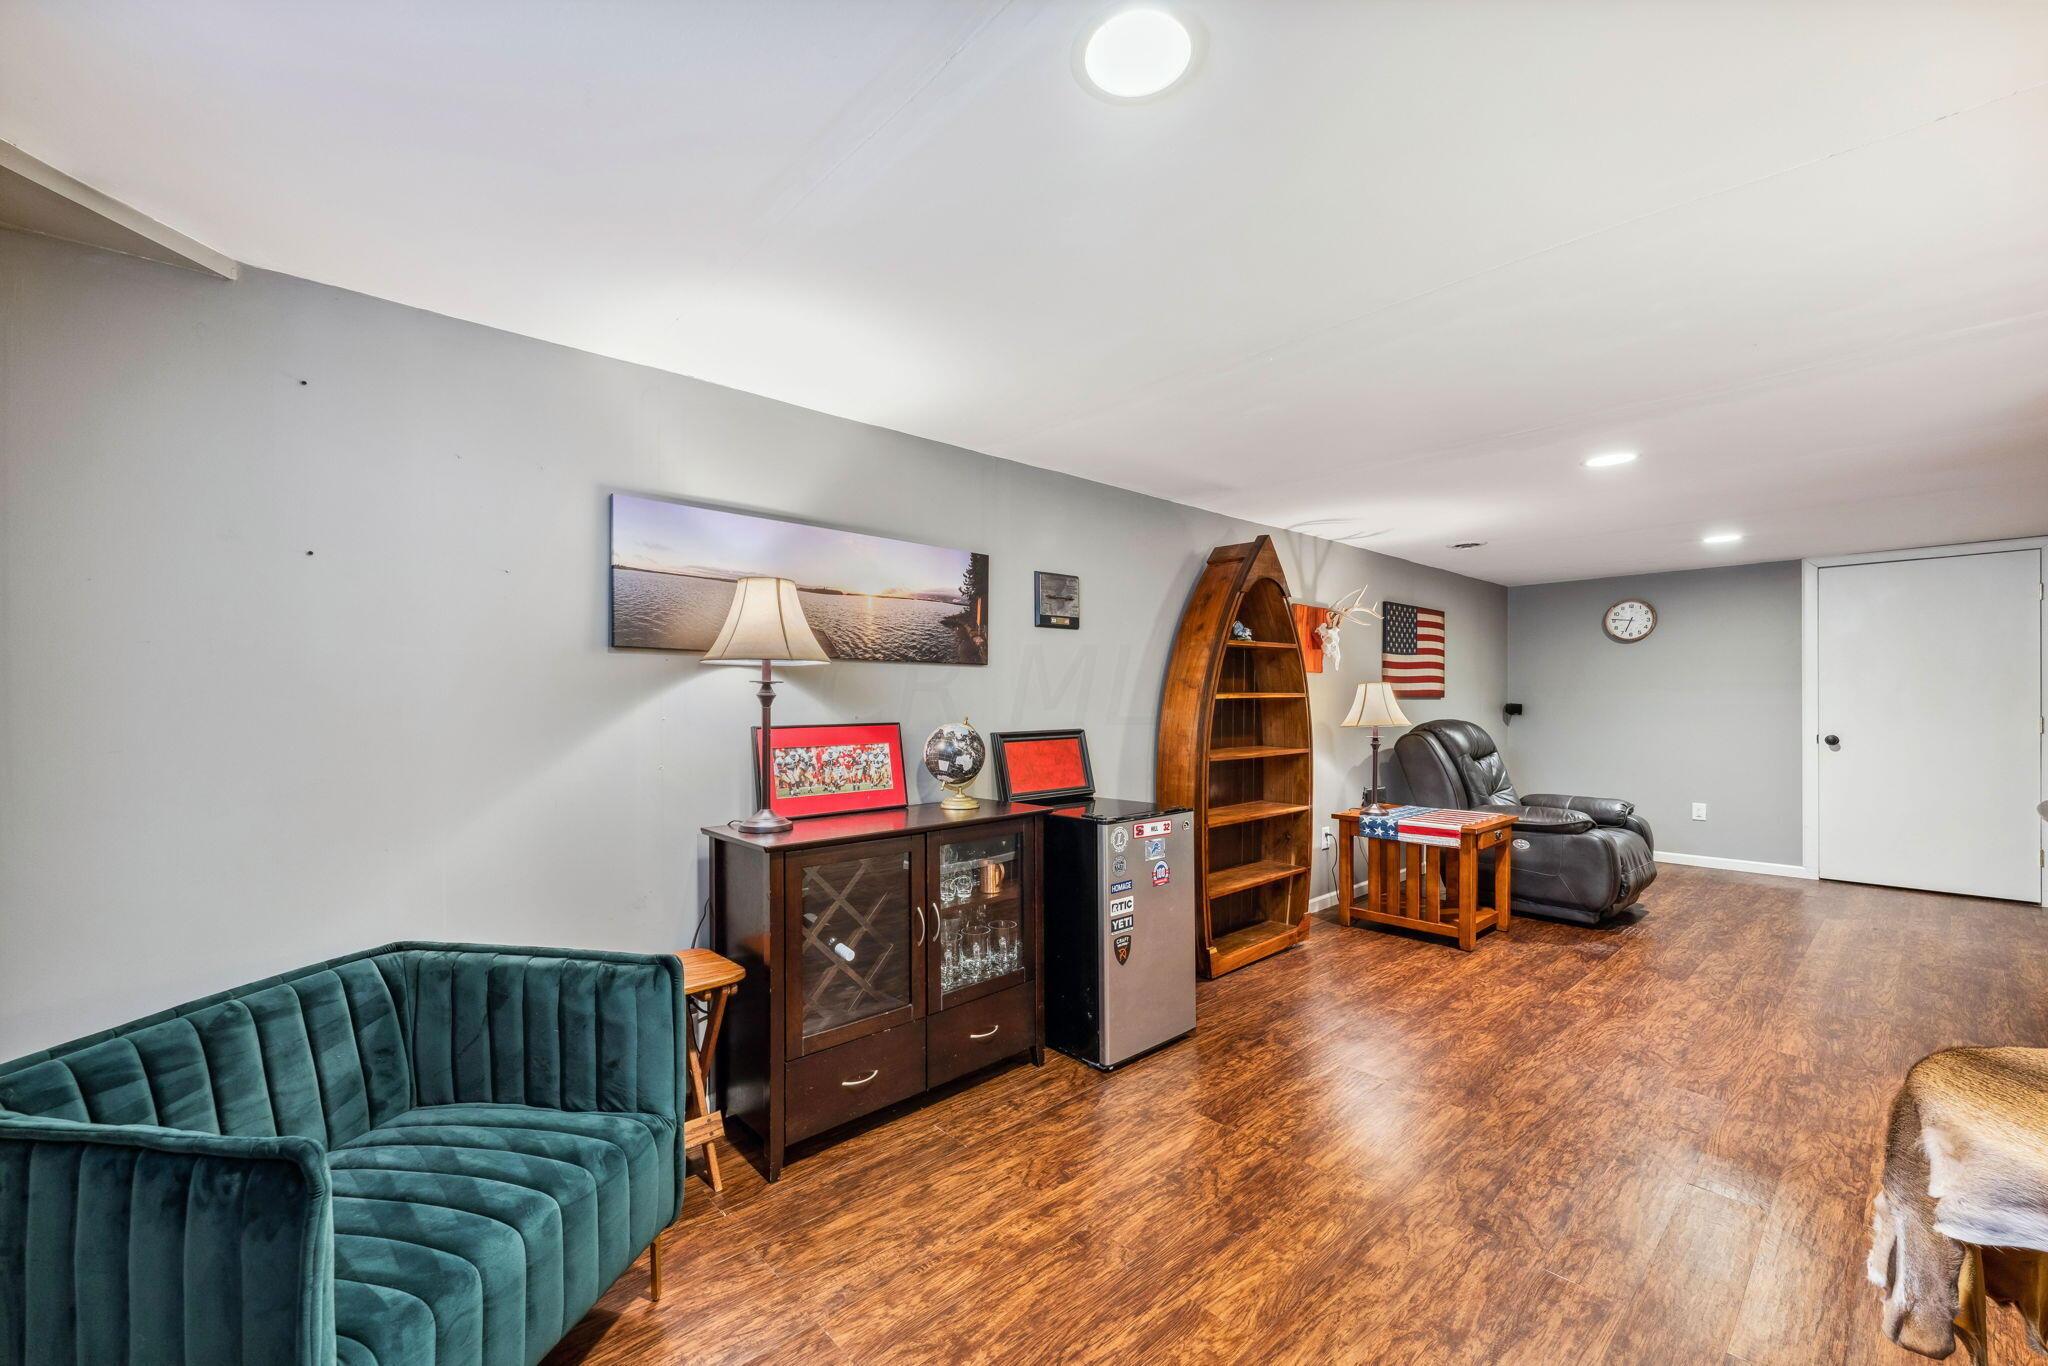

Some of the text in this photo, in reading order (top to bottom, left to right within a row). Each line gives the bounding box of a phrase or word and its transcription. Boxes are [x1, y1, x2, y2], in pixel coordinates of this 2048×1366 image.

[1112, 882, 1132, 893] HOMAGE
[1112, 900, 1132, 912] RTIC
[1112, 916, 1132, 929] YETI
